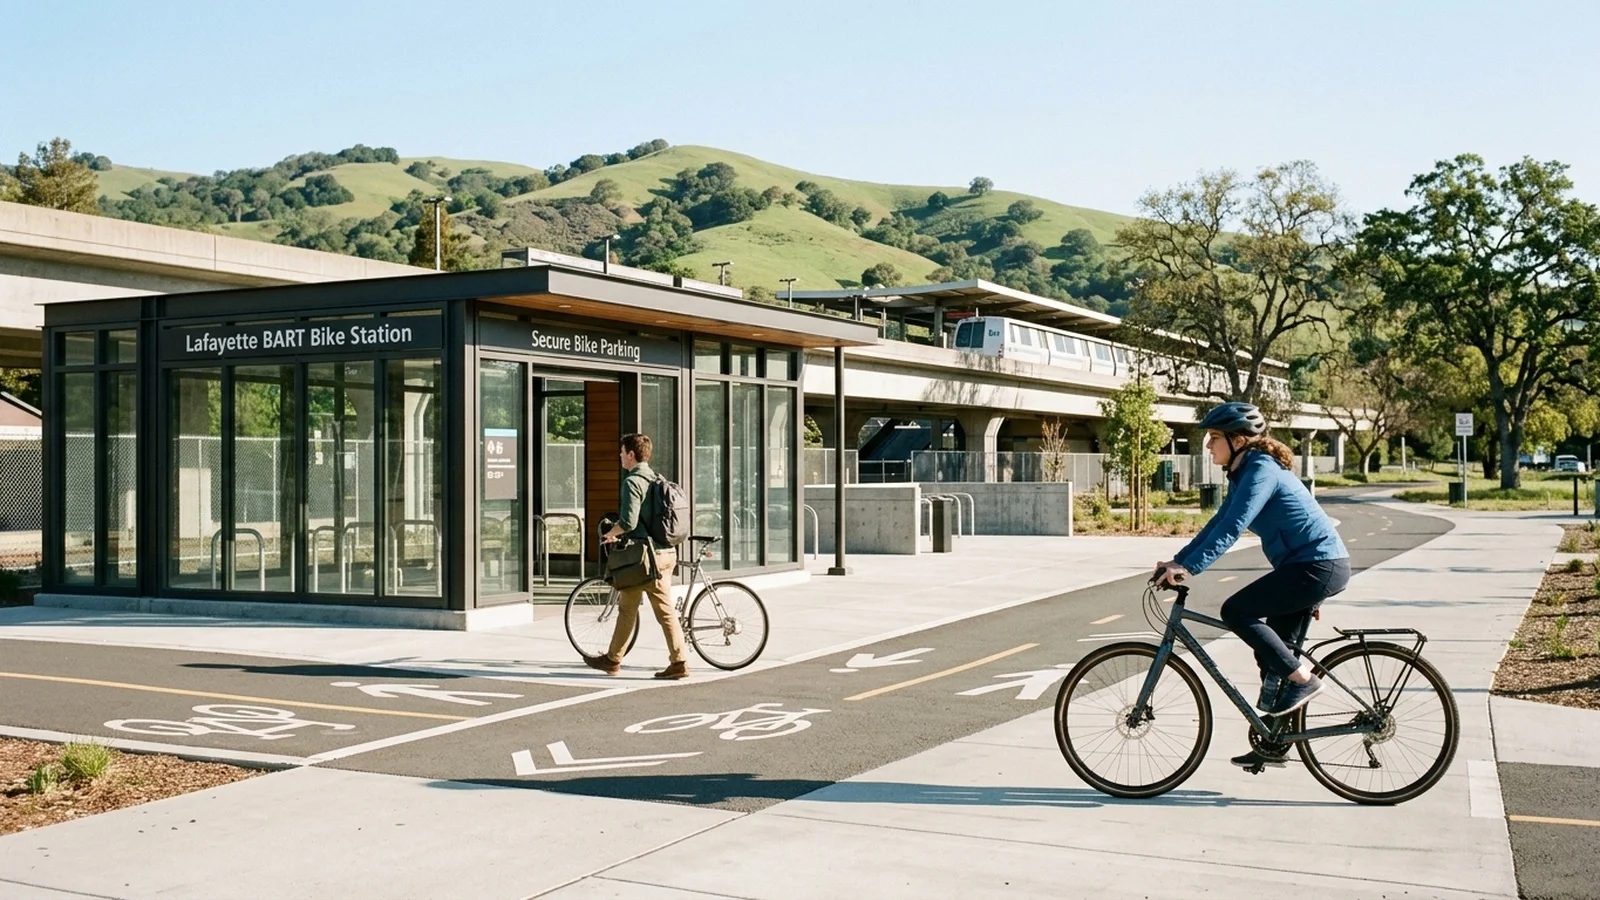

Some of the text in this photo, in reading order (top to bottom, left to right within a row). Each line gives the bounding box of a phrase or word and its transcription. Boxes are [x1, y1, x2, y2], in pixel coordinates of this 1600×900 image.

[186, 324, 413, 355] Lafayette BART Bike Station
[531, 330, 641, 363] Secure Bike Parking
